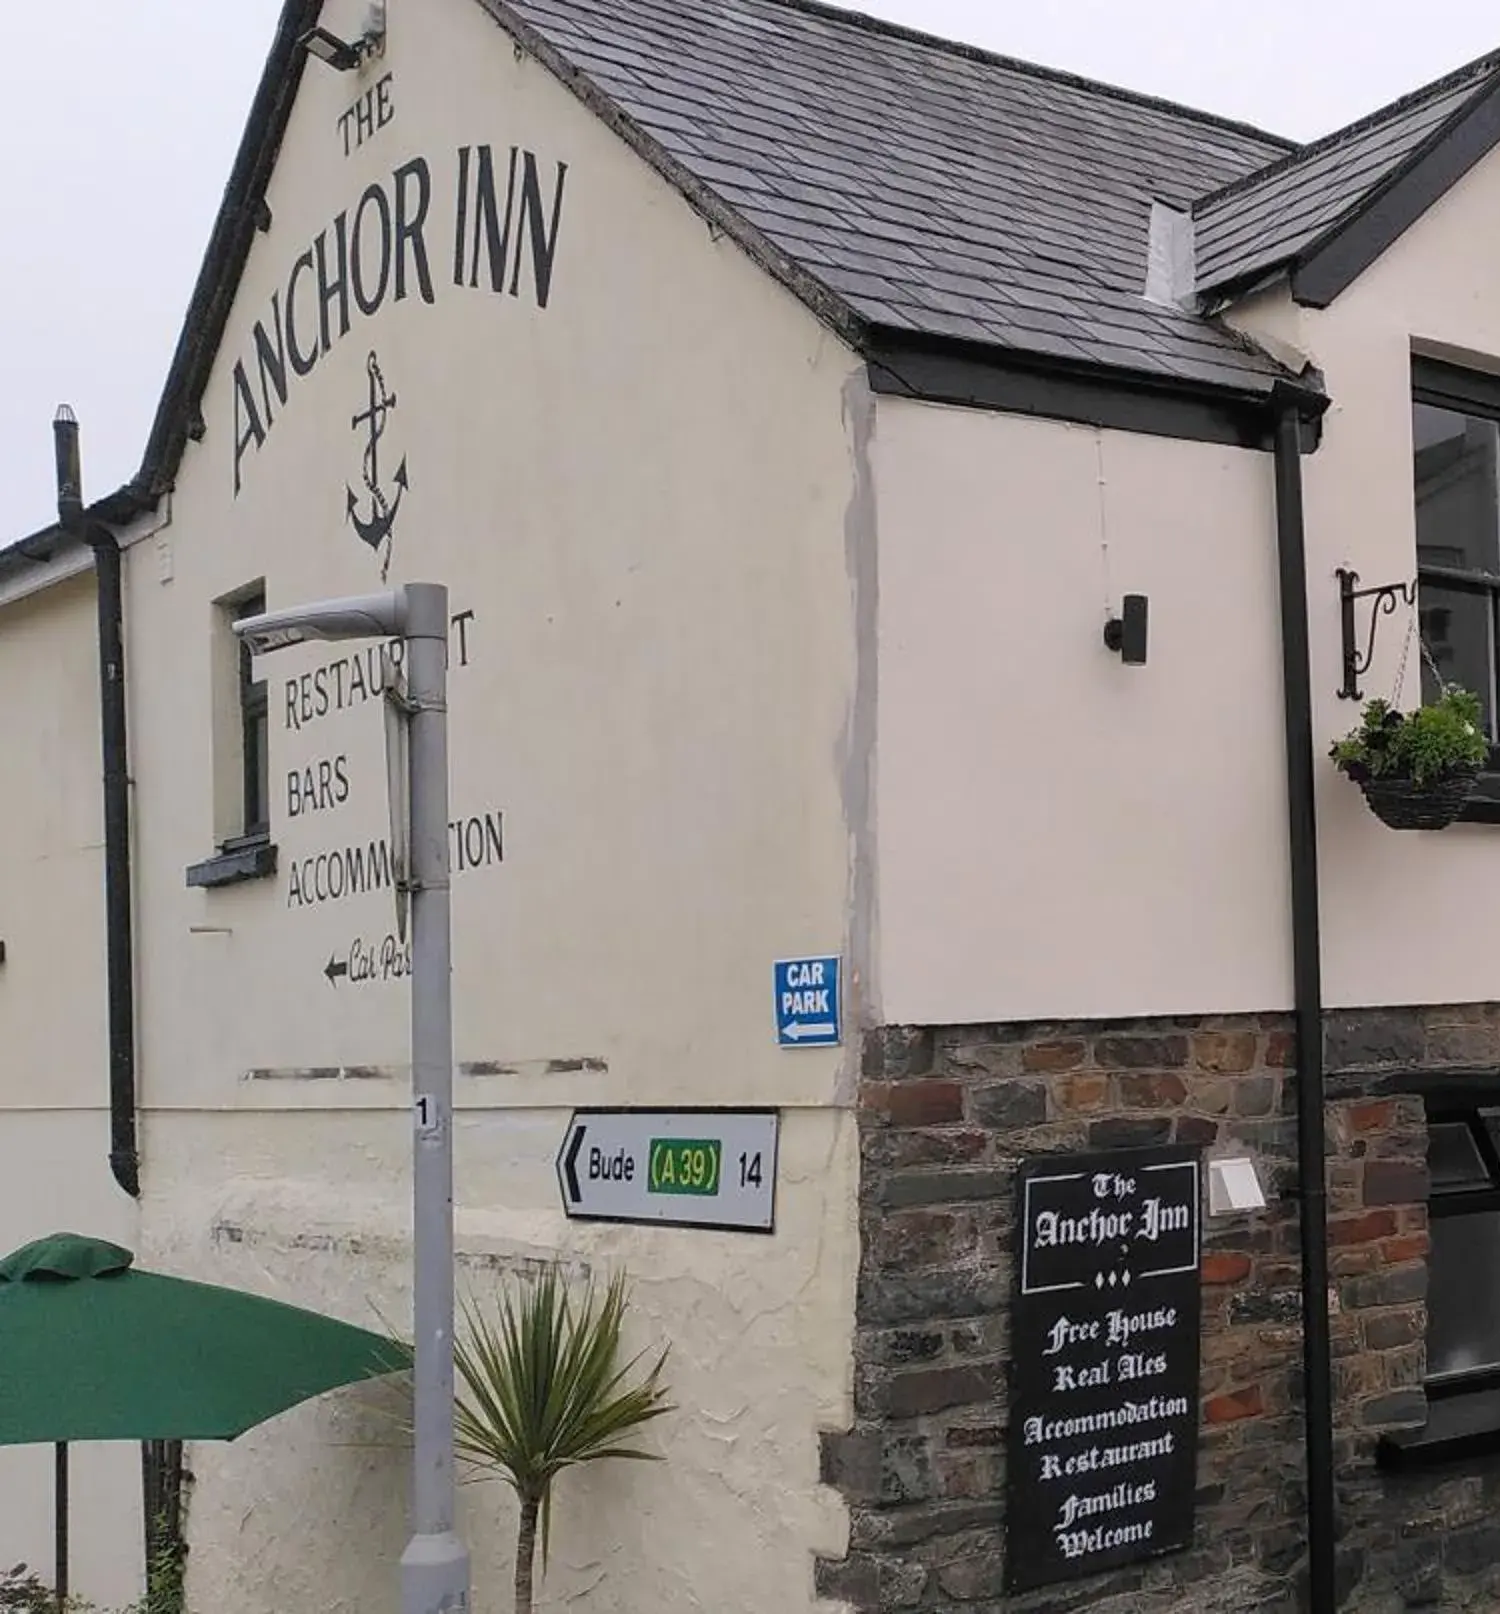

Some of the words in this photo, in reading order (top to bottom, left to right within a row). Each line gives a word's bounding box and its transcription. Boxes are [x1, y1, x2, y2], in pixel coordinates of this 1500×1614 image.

[337, 72, 395, 157] THE
[232, 156, 435, 500] ANCHOR
[453, 144, 569, 309] INN
[285, 610, 475, 730] RESTAURT
[287, 754, 350, 817] BARS
[288, 812, 503, 908] ACCOMMION
[786, 962, 825, 987] CAR
[782, 990, 830, 1015] PARK
[415, 1096, 427, 1125] 1
[589, 1147, 635, 1182] Bude
[738, 1151, 762, 1189] 14
[1091, 1172, 1137, 1203] The
[1034, 1207, 1134, 1249] Anchor
[1134, 1197, 1189, 1241] Inn
[1041, 1315, 1100, 1357] Free
[1105, 1305, 1177, 1348] House
[1051, 1358, 1111, 1392] Real
[1117, 1351, 1168, 1382] Ales
[1023, 1395, 1188, 1446] Accommodation
[1038, 1430, 1175, 1482] Restaurant
[1052, 1479, 1156, 1532] Families
[1056, 1520, 1153, 1559] Welcome
